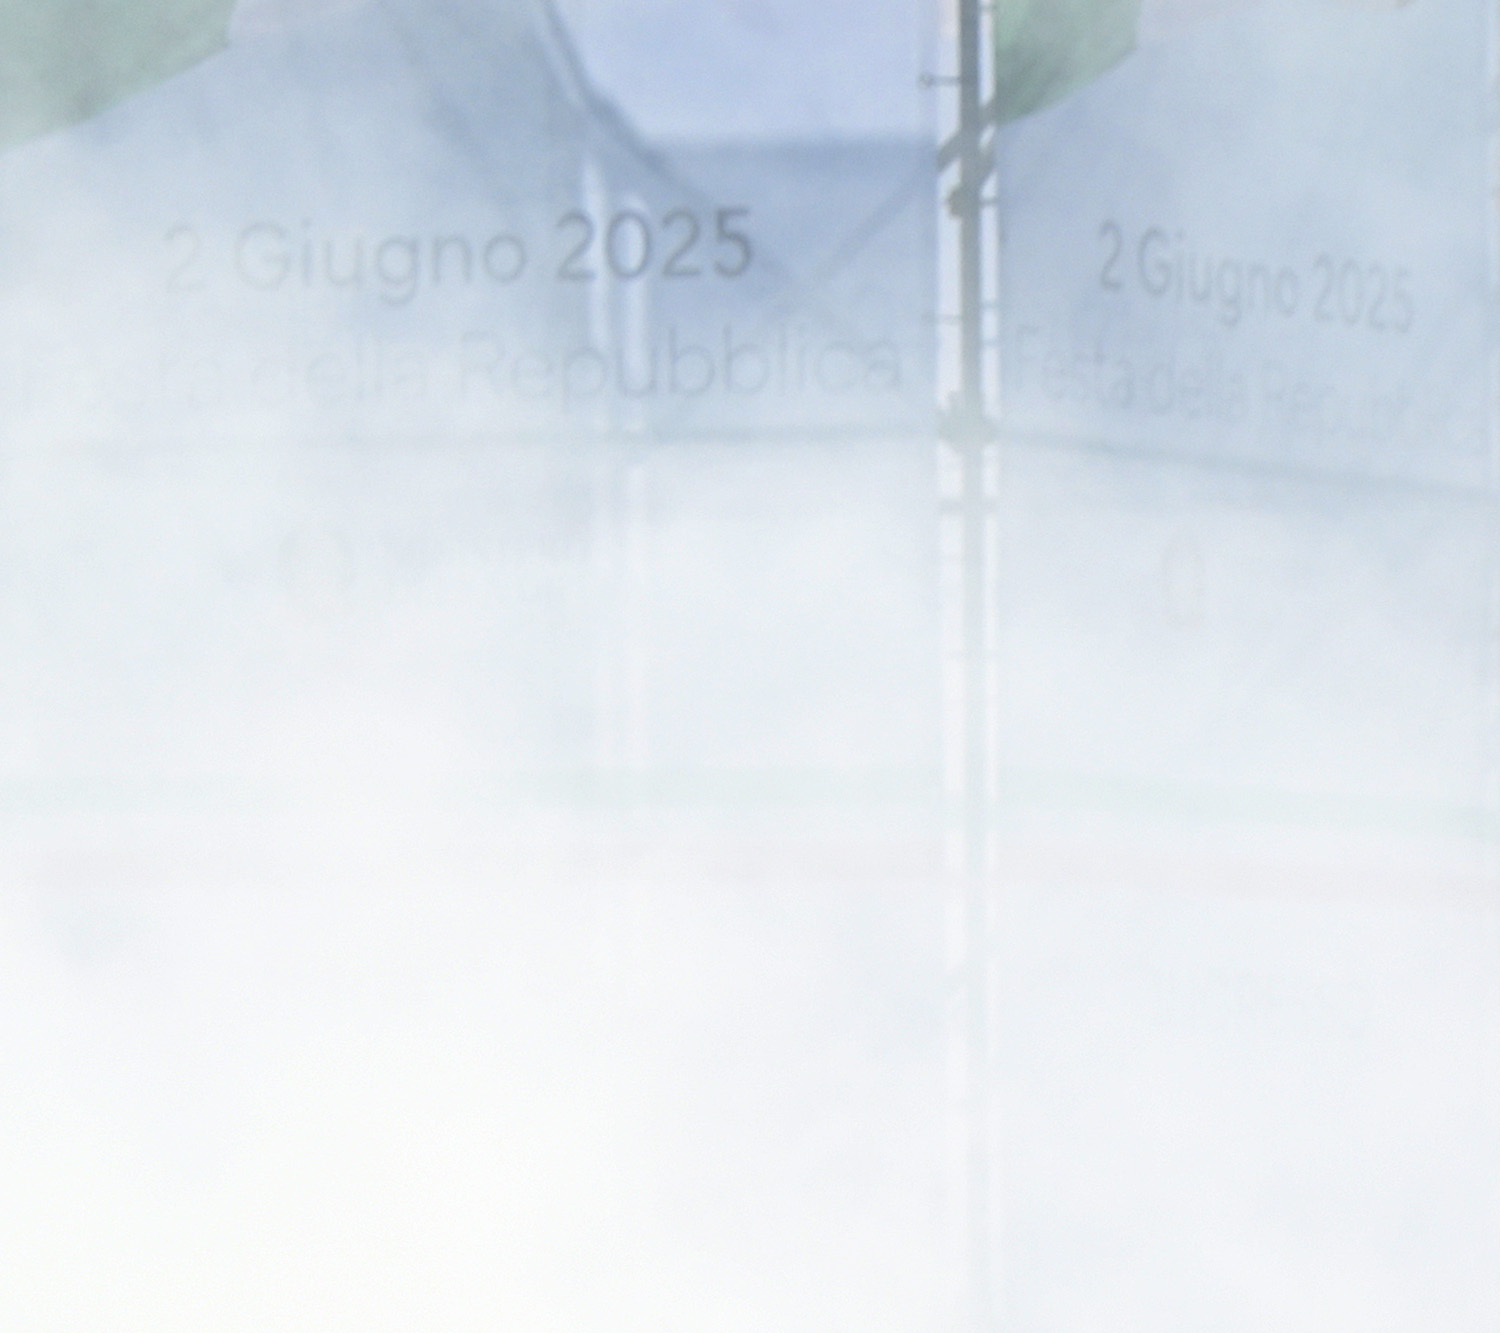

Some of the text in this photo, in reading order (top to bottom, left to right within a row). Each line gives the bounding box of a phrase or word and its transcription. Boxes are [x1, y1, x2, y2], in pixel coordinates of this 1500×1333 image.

[234, 218, 529, 307] Giugno
[555, 206, 757, 284] 2025
[1098, 219, 1416, 336] 2 Giugno 2025
[458, 322, 904, 414] Repubblica
